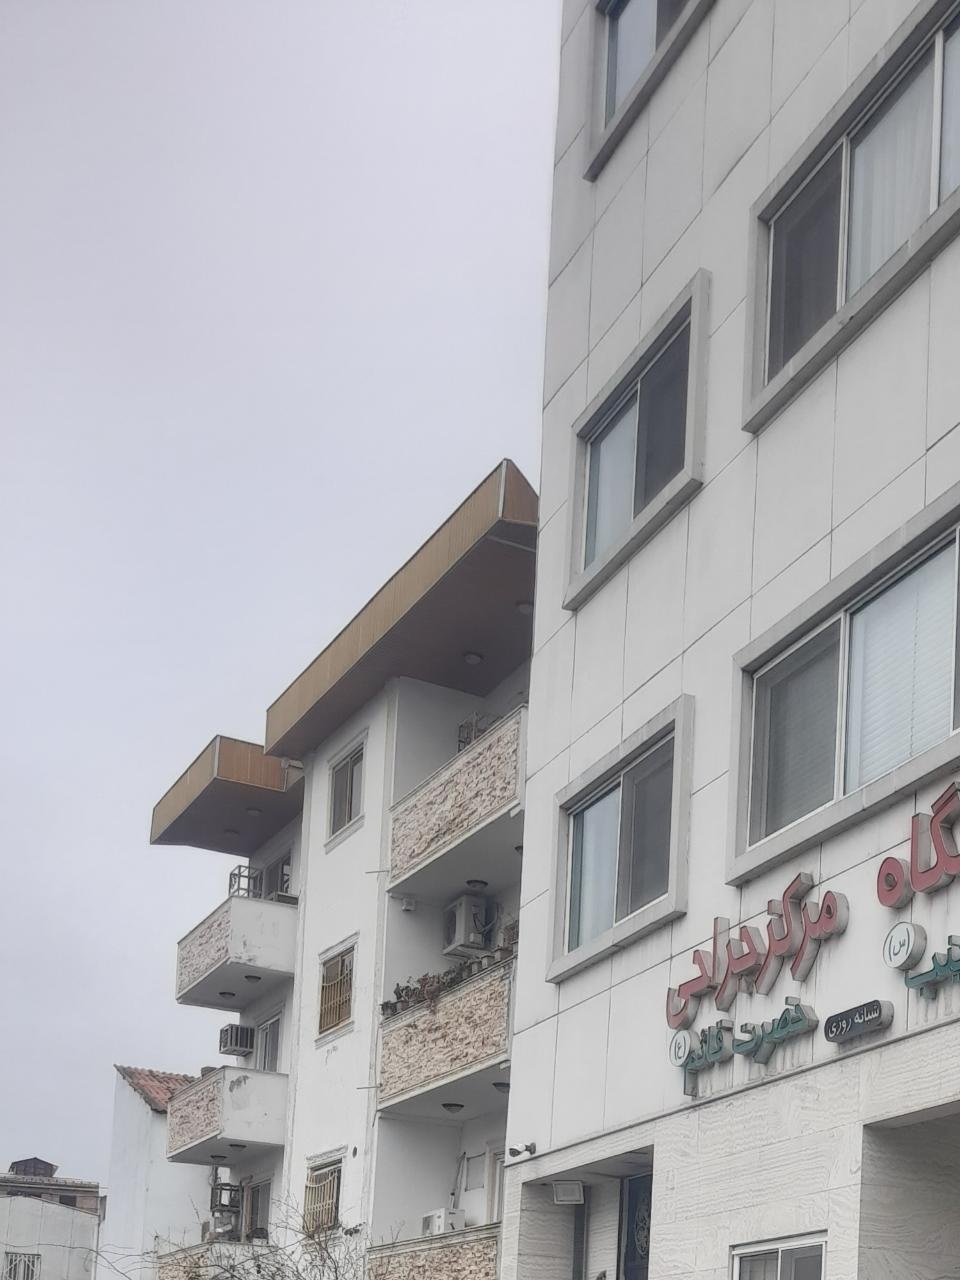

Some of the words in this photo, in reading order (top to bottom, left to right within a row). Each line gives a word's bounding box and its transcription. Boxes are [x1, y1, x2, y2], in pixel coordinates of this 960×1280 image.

[755, 872, 849, 995] مرکز
[666, 916, 768, 1029] جراحی
[732, 997, 819, 1064] حضرت
[828, 1017, 852, 1037] روزی
[854, 1005, 880, 1025] شبانه
